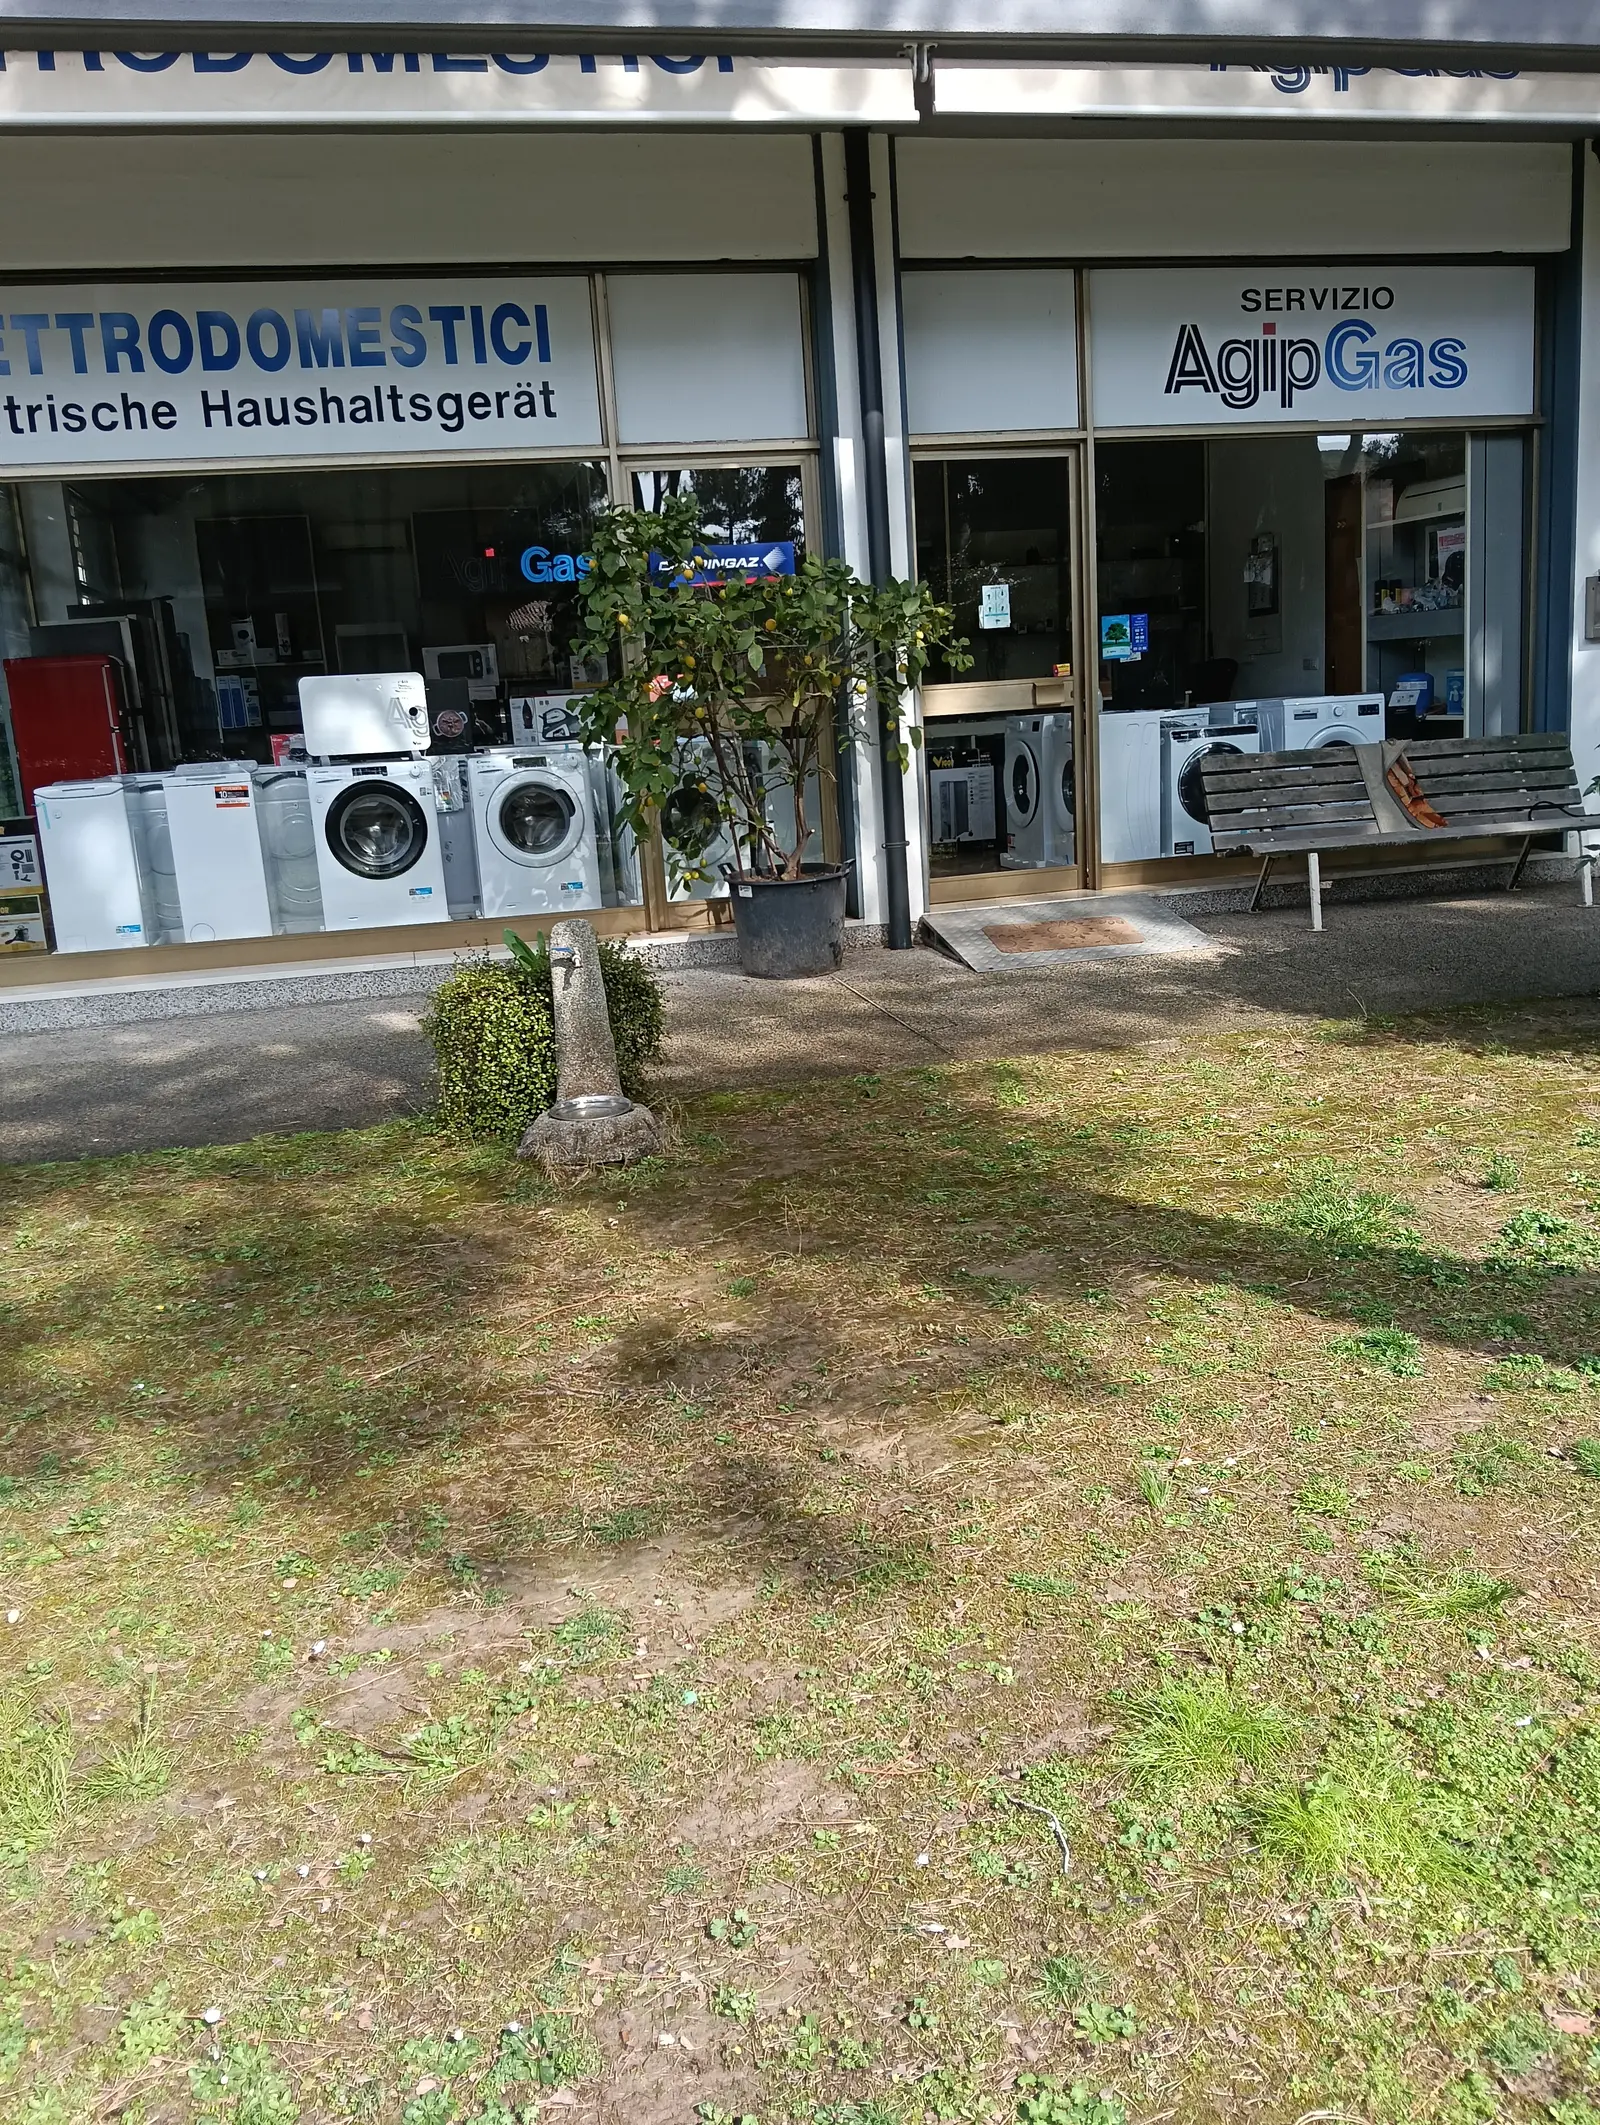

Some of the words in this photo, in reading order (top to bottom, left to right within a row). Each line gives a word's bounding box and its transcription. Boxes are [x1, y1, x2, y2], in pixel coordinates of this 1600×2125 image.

[1240, 286, 1395, 312] SERVIZIO
[0, 302, 551, 375] TTRODOMESTICI
[3, 393, 178, 434] trische
[201, 381, 558, 432] Haushaltsgerät
